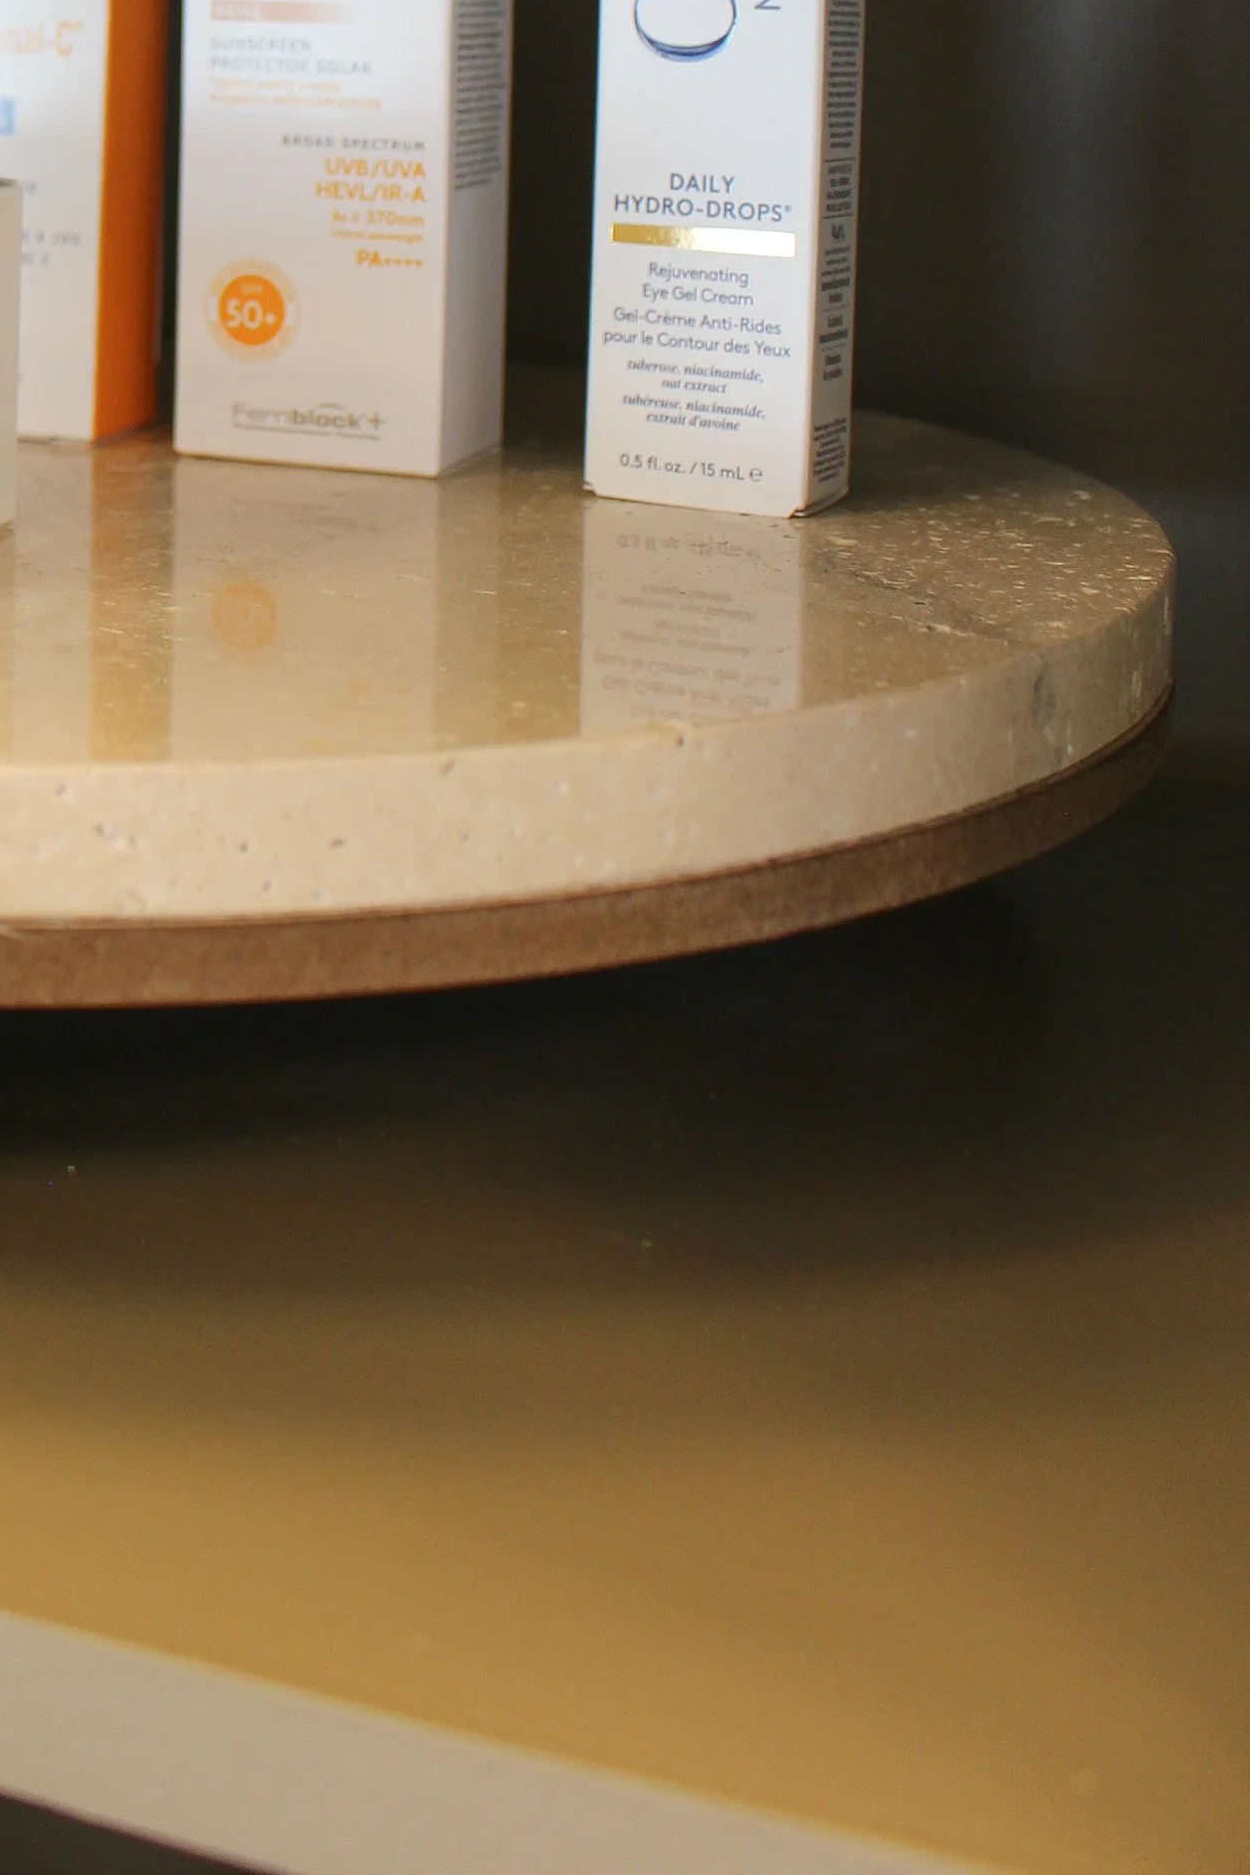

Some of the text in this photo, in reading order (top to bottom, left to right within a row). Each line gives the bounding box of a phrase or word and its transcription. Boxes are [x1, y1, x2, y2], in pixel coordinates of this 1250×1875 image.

[209, 36, 312, 53] SUNSCREEN
[210, 56, 372, 75] PROTECTOR SOLAR
[342, 137, 426, 152] SPECTRUM
[324, 157, 427, 179] UVB/UVA
[670, 173, 735, 193] DAILY
[649, 261, 749, 288] Rejuvenating
[642, 283, 754, 307] Eye Gel Cream
[226, 297, 277, 330] 50+
[613, 307, 782, 336] Gel-Crème Anti-Rides
[603, 330, 792, 358] pour le Contour des Yeux
[627, 358, 764, 383] tuberose, niacinamide,
[684, 380, 728, 394] extract
[686, 399, 766, 420] niacinamide,
[646, 412, 741, 432] extrait d'avoine
[619, 453, 643, 469] 0.5
[647, 456, 662, 471] fl.
[665, 461, 687, 474] oz.
[690, 462, 697, 475] /
[700, 462, 716, 477] 15
[720, 466, 745, 481] mL
